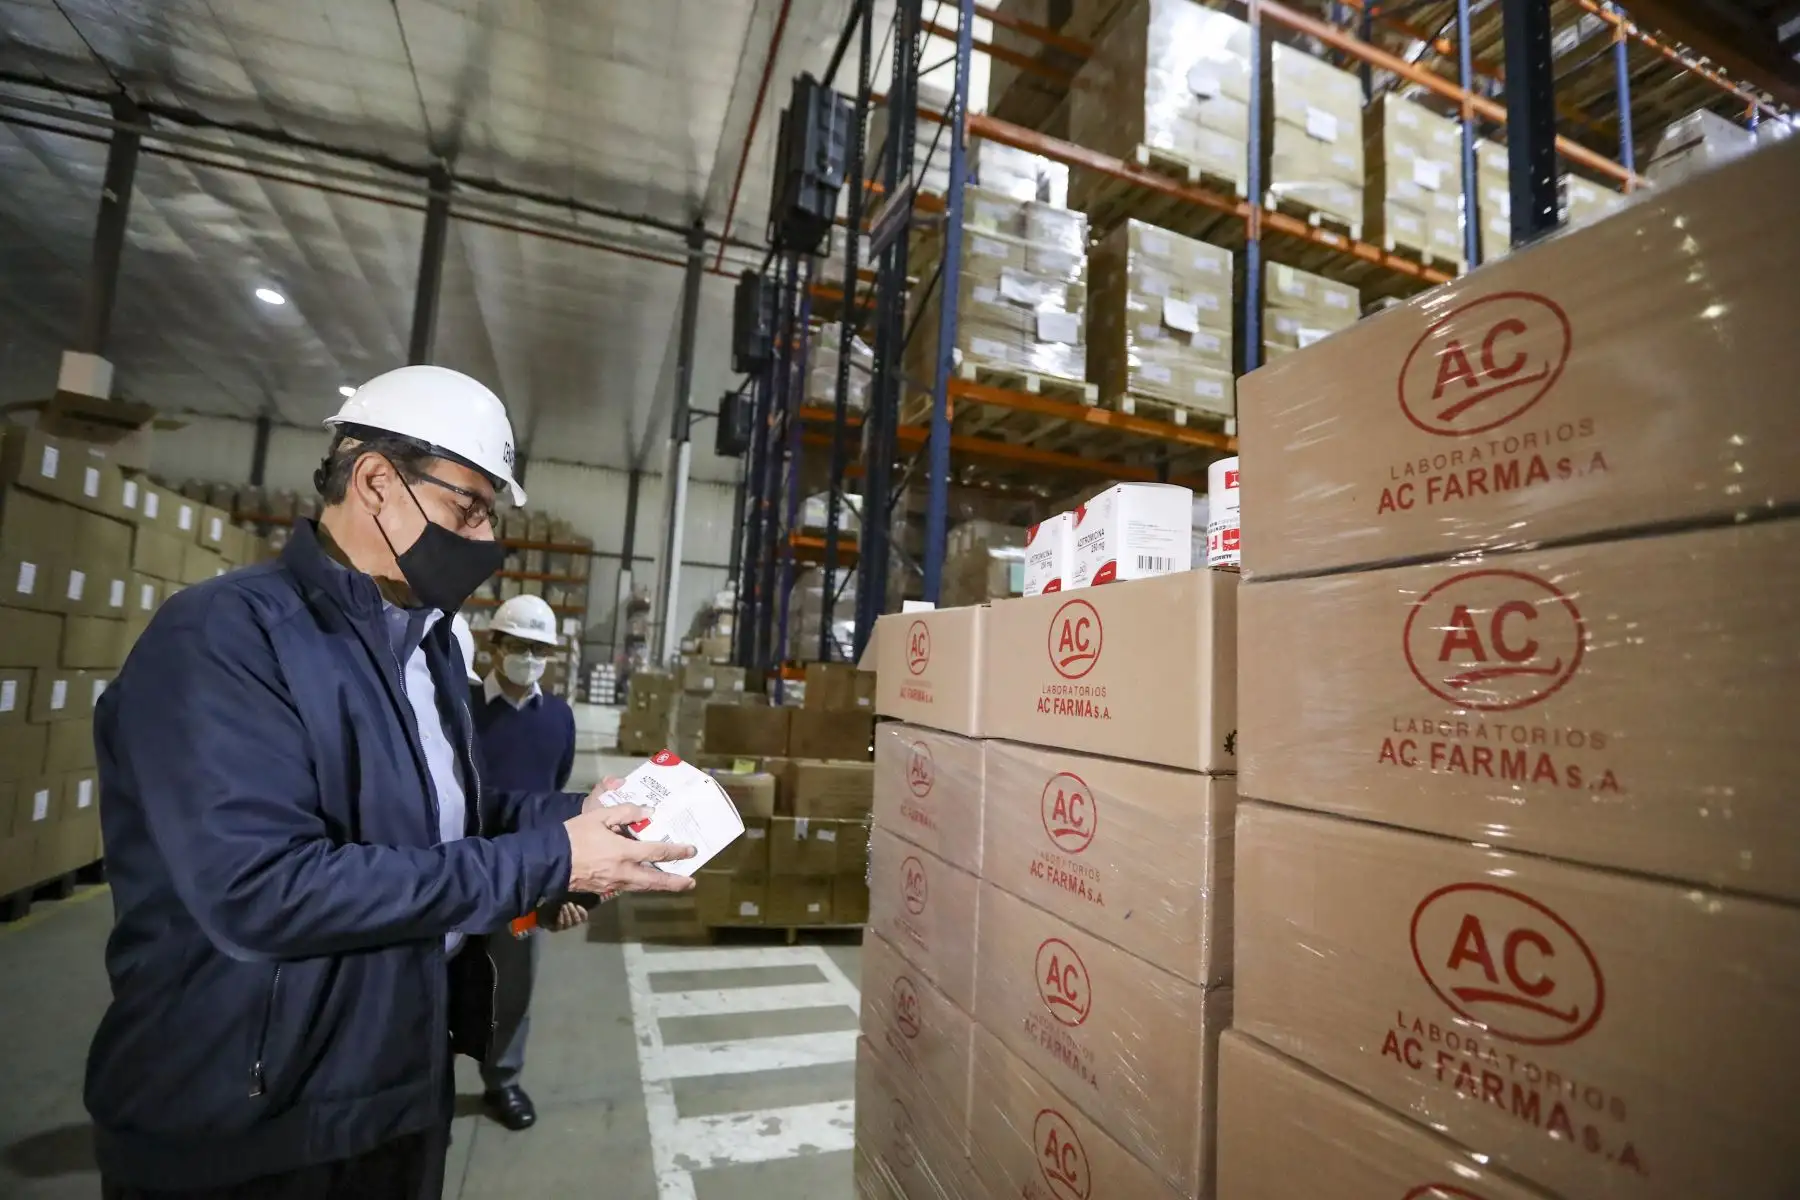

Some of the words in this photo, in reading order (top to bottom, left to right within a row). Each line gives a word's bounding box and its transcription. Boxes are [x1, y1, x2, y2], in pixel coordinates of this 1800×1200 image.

[1431, 317, 1529, 400] AC
[1390, 417, 1594, 480] LABORATORIOS
[1377, 482, 1414, 515] AC
[911, 632, 926, 657] AC
[1058, 617, 1091, 653] AC
[1438, 600, 1538, 662] AC
[1037, 696, 1051, 714] AC
[1042, 684, 1107, 698] LABORATORIOS
[1378, 737, 1417, 767] AC
[1392, 717, 1607, 751] LABORATORIOS
[1051, 789, 1085, 829] AC
[1030, 859, 1044, 878] AC
[1446, 914, 1556, 998] AC
[1045, 954, 1078, 1002] AC
[1381, 1029, 1422, 1070] AC
[1044, 1127, 1078, 1183] AC
